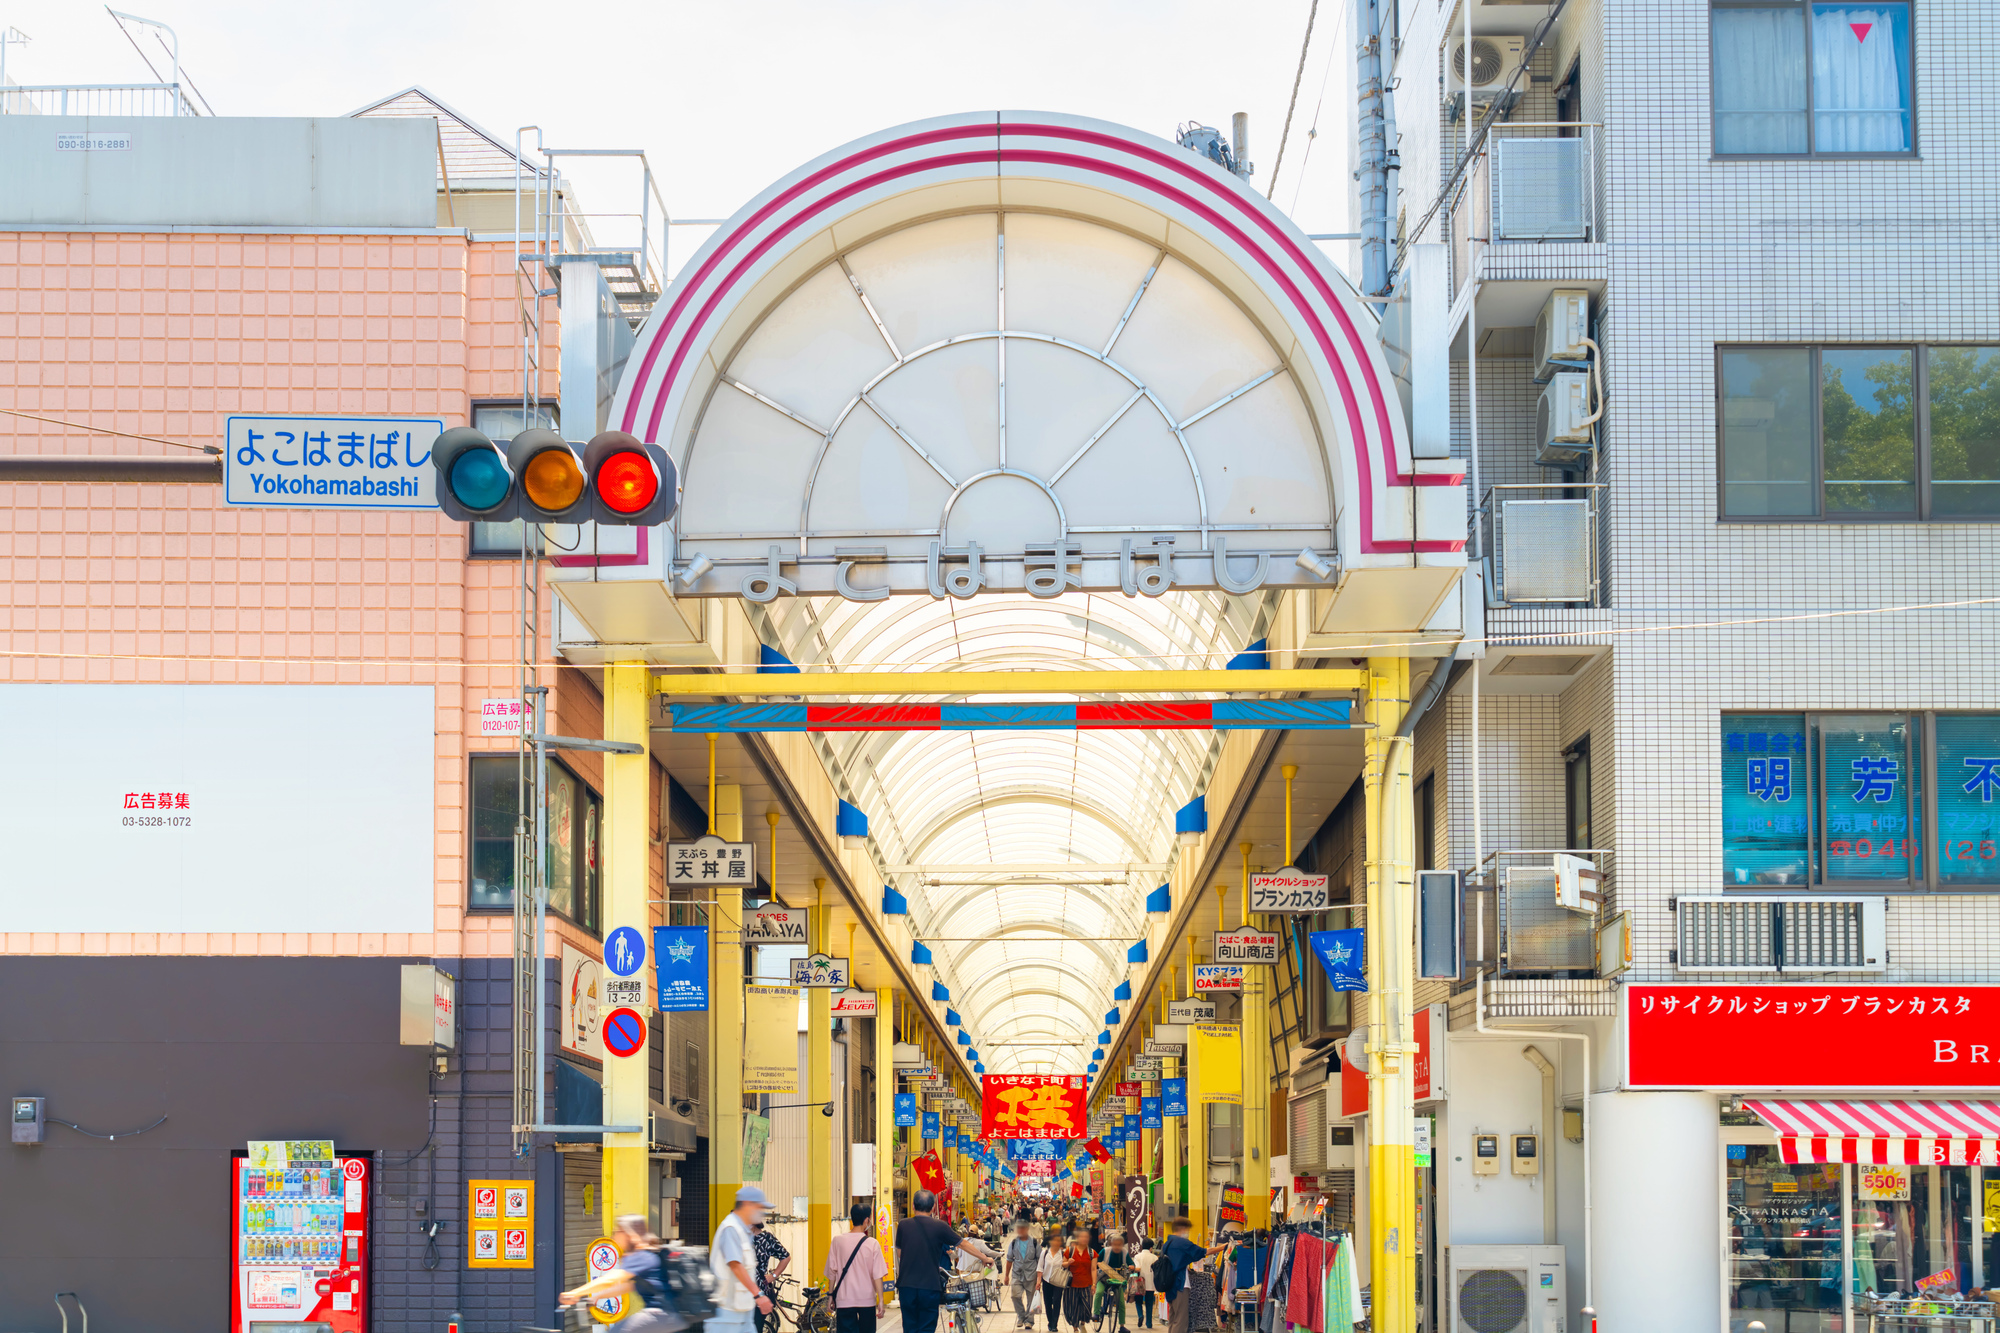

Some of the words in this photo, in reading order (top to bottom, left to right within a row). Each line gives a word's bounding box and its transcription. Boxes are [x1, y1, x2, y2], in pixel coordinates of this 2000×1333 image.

[58, 140, 130, 149] 090-8816-2881
[236, 428, 431, 468] よこはまばし
[250, 473, 419, 497] Yokohamabashi
[740, 535, 1271, 603] よこはまばし
[123, 792, 190, 809] 広告募集
[122, 816, 192, 826] 03-5328-1072
[675, 860, 746, 878] 天丼屋
[1253, 877, 1326, 887] リサイクルショップ
[1253, 888, 1326, 907] ブランカスタ
[1218, 945, 1275, 959] 向山商店
[796, 969, 844, 985] 海の家
[606, 980, 642, 991] 歩行者用道路
[1640, 995, 1832, 1015] リサイクルショップ
[1840, 995, 1972, 1016] ブランカスタ
[1170, 1008, 1191, 1016] 三代目
[1193, 1007, 1215, 1018] 茂蔵
[990, 1076, 1066, 1085] いきな下町
[1130, 1071, 1157, 1079] さとう
[987, 1128, 1081, 1139] よこはまばし
[1861, 1165, 1878, 1175] 店内
[1863, 1175, 1907, 1189] 550円
[1892, 1190, 1909, 1200] より
